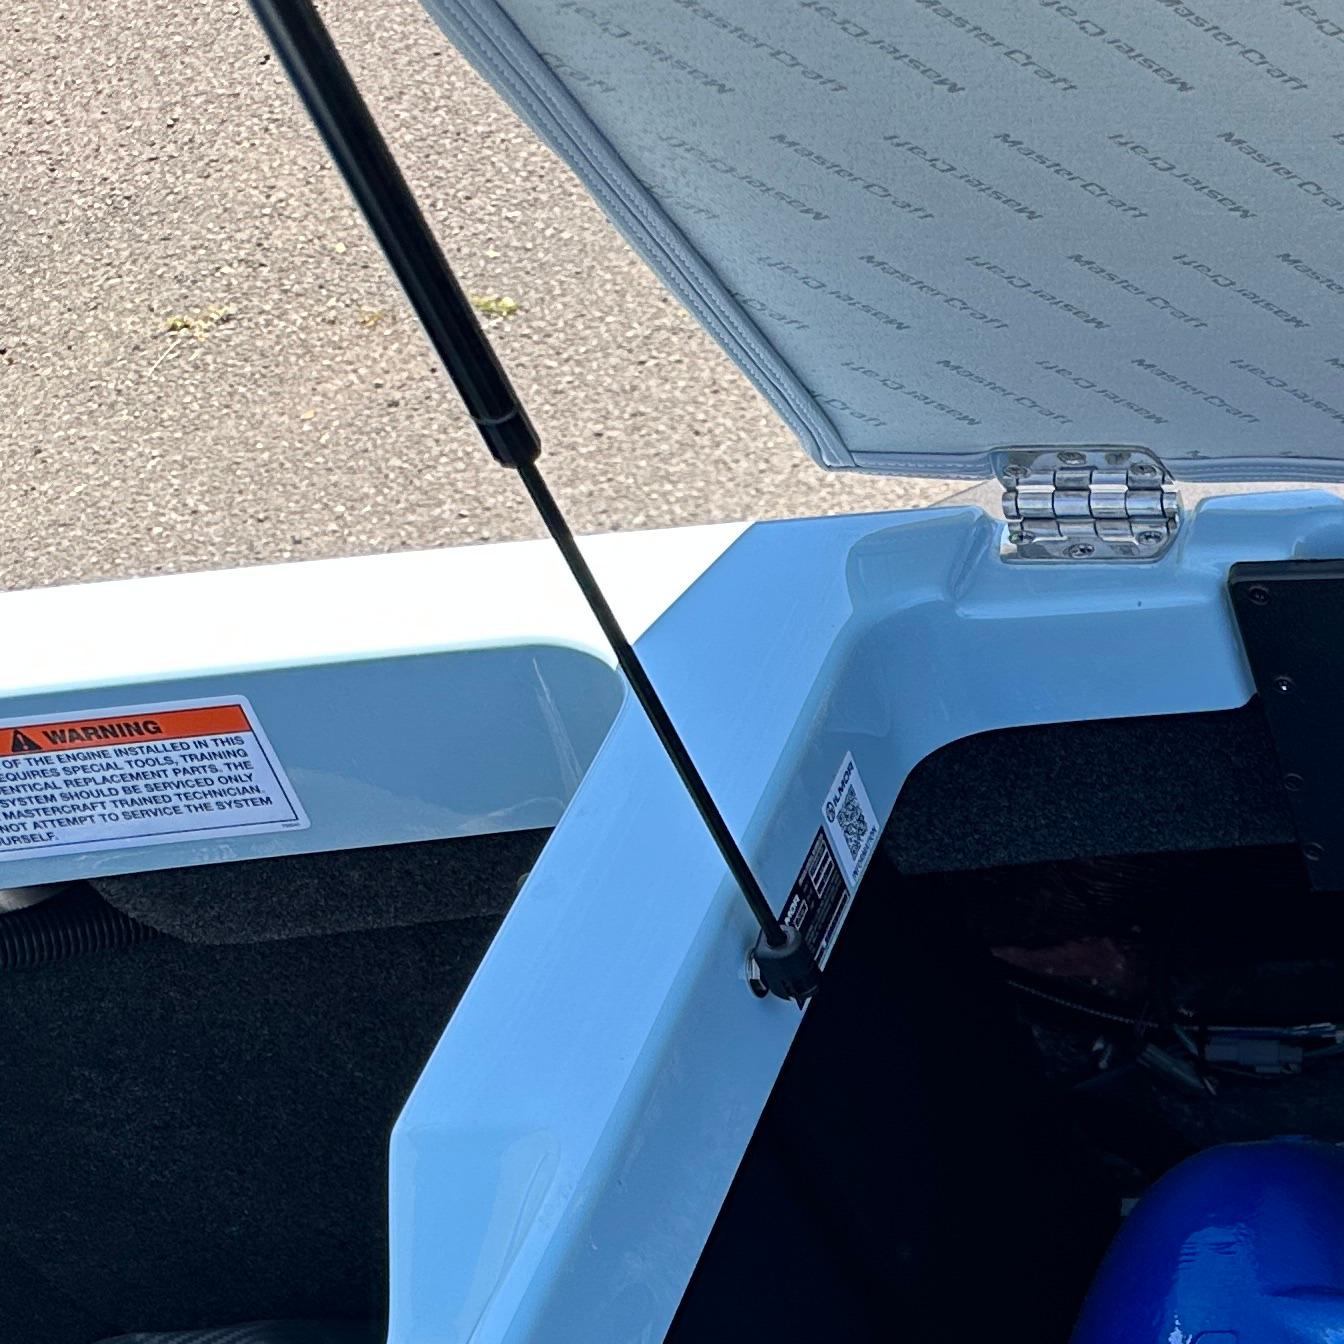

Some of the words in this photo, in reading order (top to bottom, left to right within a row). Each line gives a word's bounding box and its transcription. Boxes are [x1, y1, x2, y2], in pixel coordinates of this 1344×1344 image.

[769, 134, 935, 219] MasterCraft
[884, 134, 1043, 220] MasterCraft
[995, 133, 1149, 219] MasterCraft
[1108, 133, 1257, 219] MasterCraft
[858, 255, 1009, 329] MasterCraft
[964, 255, 1110, 330] MasterCraft
[1067, 254, 1208, 328] MasterCraft
[1173, 254, 1310, 328] MasterCraft
[1131, 359, 1260, 424] MasterCraft
[2, 759, 21, 769] OF
[24, 755, 52, 767] THE
[56, 749, 112, 764] ENGINE
[114, 741, 191, 757] INSTALLED
[195, 739, 207, 749] IN
[210, 735, 245, 746] THIS
[42, 720, 162, 745] WARNING
[0, 768, 60, 783] EQUIRES
[62, 761, 124, 776] SPECIAL
[124, 756, 179, 769] TOOLS,
[180, 748, 249, 763] TRAINING
[0, 780, 62, 795] ENTICAL
[63, 770, 171, 789] REPLACEMENT
[173, 764, 224, 777] PARTS.
[224, 761, 254, 771] THE
[0, 794, 57, 809] SYSTEM
[60, 787, 119, 801] SHOULD
[121, 784, 144, 795] BE
[144, 776, 215, 793] SERVICED
[217, 773, 254, 786] ONLY
[833, 761, 855, 808] ILMOR
[0, 822, 27, 834] NOT
[33, 814, 96, 830] ATTEMPT
[97, 812, 119, 823] TO
[122, 804, 183, 820] SERVICE
[184, 802, 214, 814] THE
[216, 796, 273, 810] SYSTEM
[2, 801, 107, 820] MASTERCRAFT
[109, 794, 172, 809] TRAINED
[174, 785, 265, 801] TECHNICIAN.
